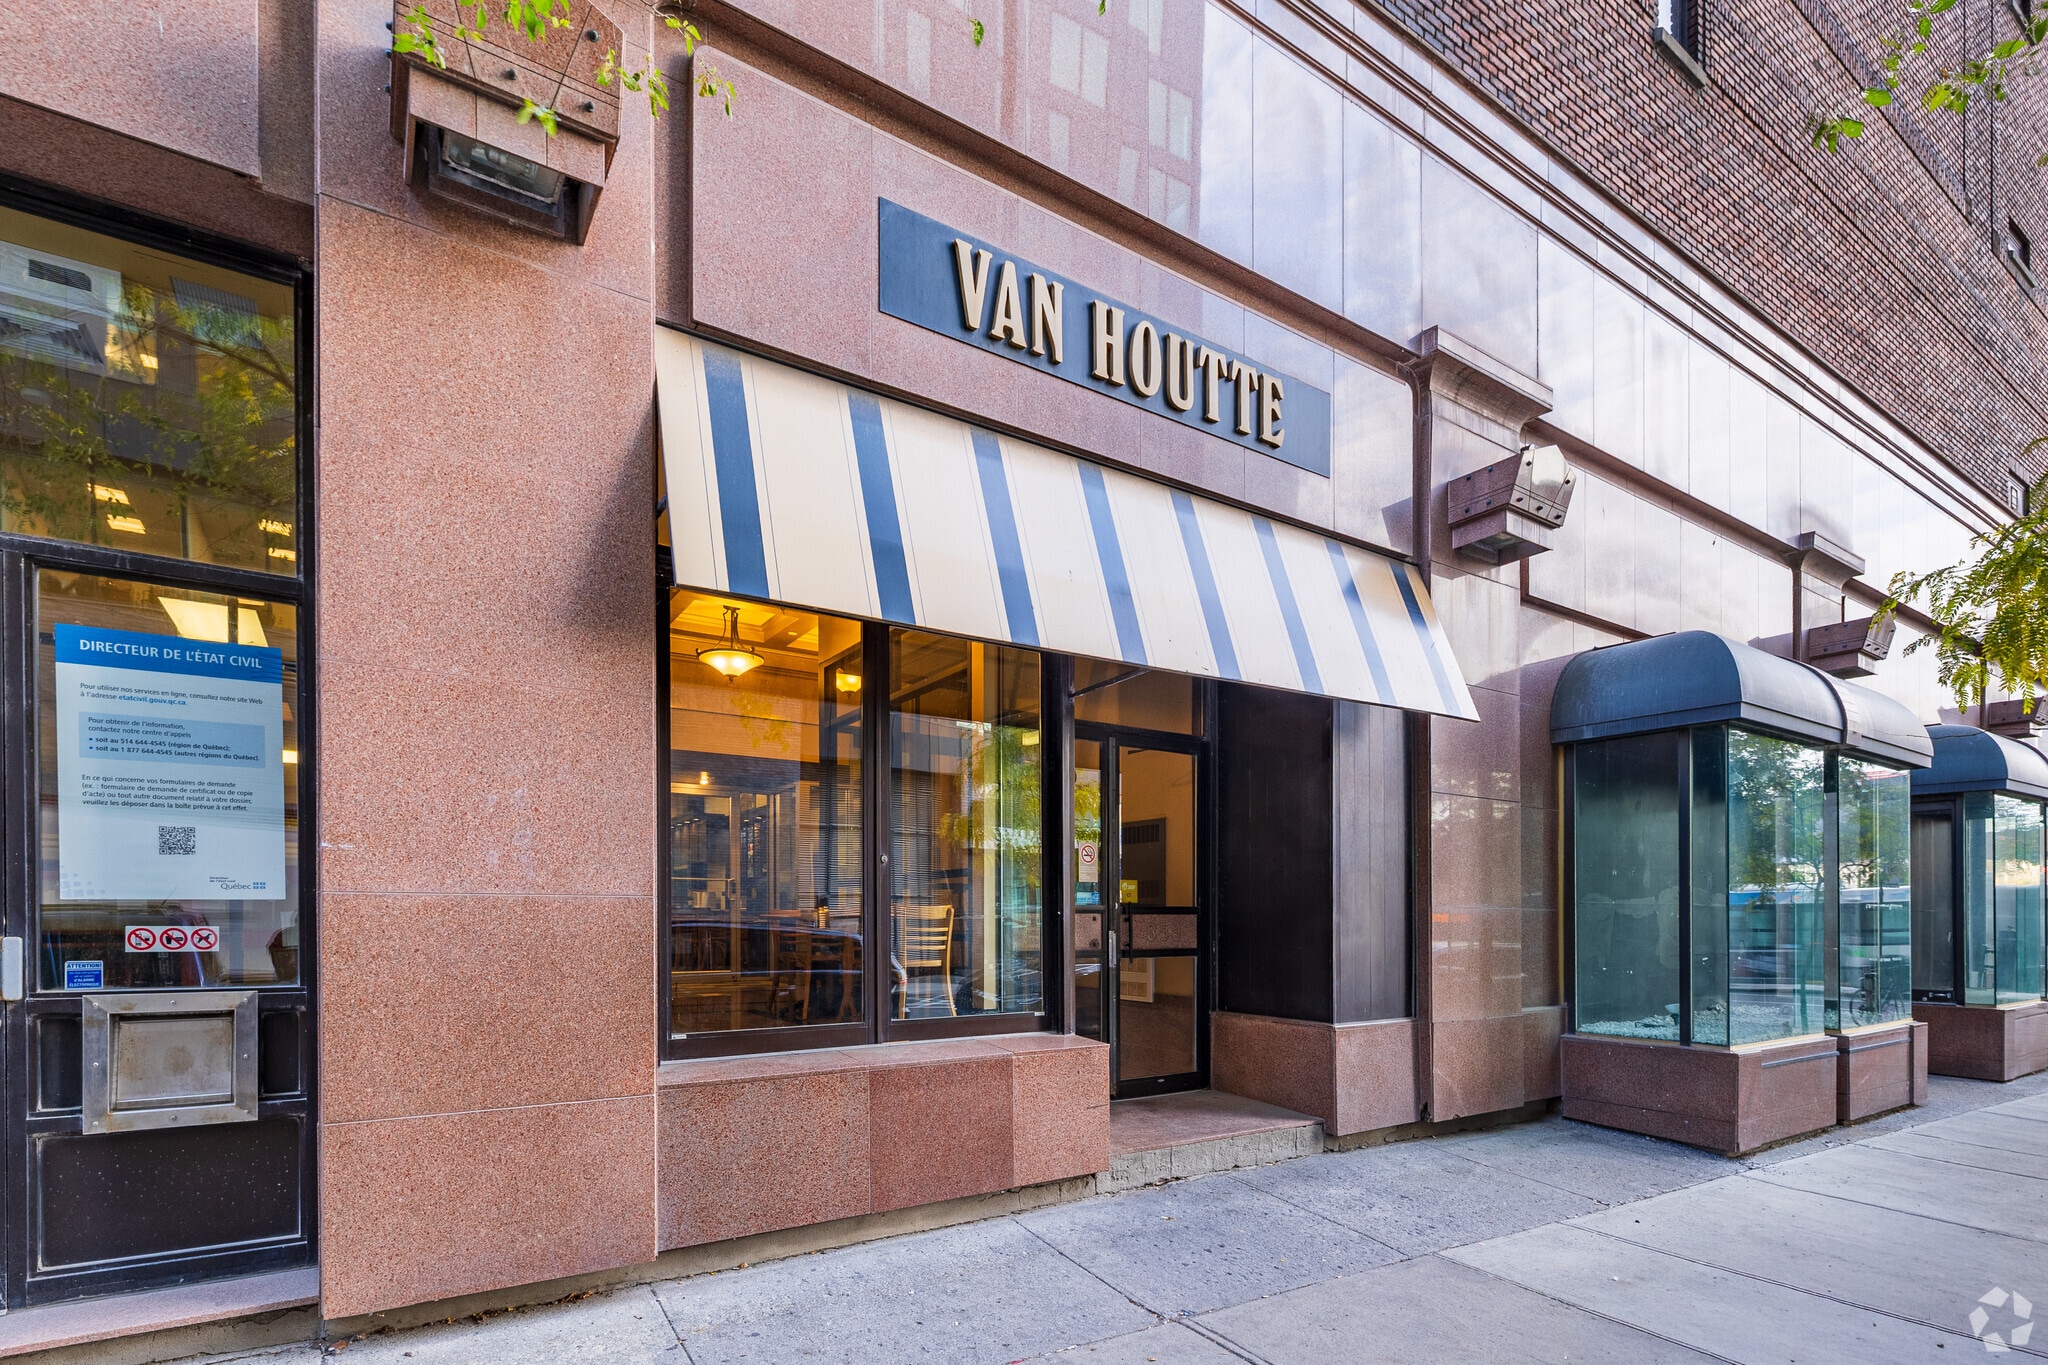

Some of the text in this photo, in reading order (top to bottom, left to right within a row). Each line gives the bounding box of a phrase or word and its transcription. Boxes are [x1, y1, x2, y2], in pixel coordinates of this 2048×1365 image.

[953, 238, 1286, 449] VAN HOUTTE
[79, 639, 262, 669] DIRECTEUR DE L'ÉTAT CIVIL
[80, 682, 96, 690] Pour
[96, 683, 119, 692] utiliser
[134, 686, 160, 696] services
[170, 690, 188, 700] ligne,
[189, 692, 218, 701] consultez
[219, 695, 236, 703] notre
[248, 697, 263, 705] Web
[86, 691, 117, 700] l'adresse
[88, 716, 104, 724] Pour
[105, 717, 130, 726] obtenir
[131, 719, 141, 727] de
[88, 725, 120, 734] contactez
[122, 727, 141, 735] notre
[141, 729, 163, 737] centre
[95, 736, 109, 744] soit
[134, 739, 166, 747] 644-4545
[95, 744, 109, 752] soit
[141, 747, 173, 756] 644-4545
[174, 748, 197, 757] (autres
[198, 751, 222, 760] régions
[102, 775, 113, 783] qui
[159, 778, 195, 786] formulaires
[206, 780, 236, 788] demande
[100, 783, 135, 791] formulaire
[147, 785, 178, 793] demande
[189, 787, 216, 795] certificat
[151, 793, 185, 801] document
[121, 800, 148, 808] déposer
[220, 882, 252, 891] Québec
